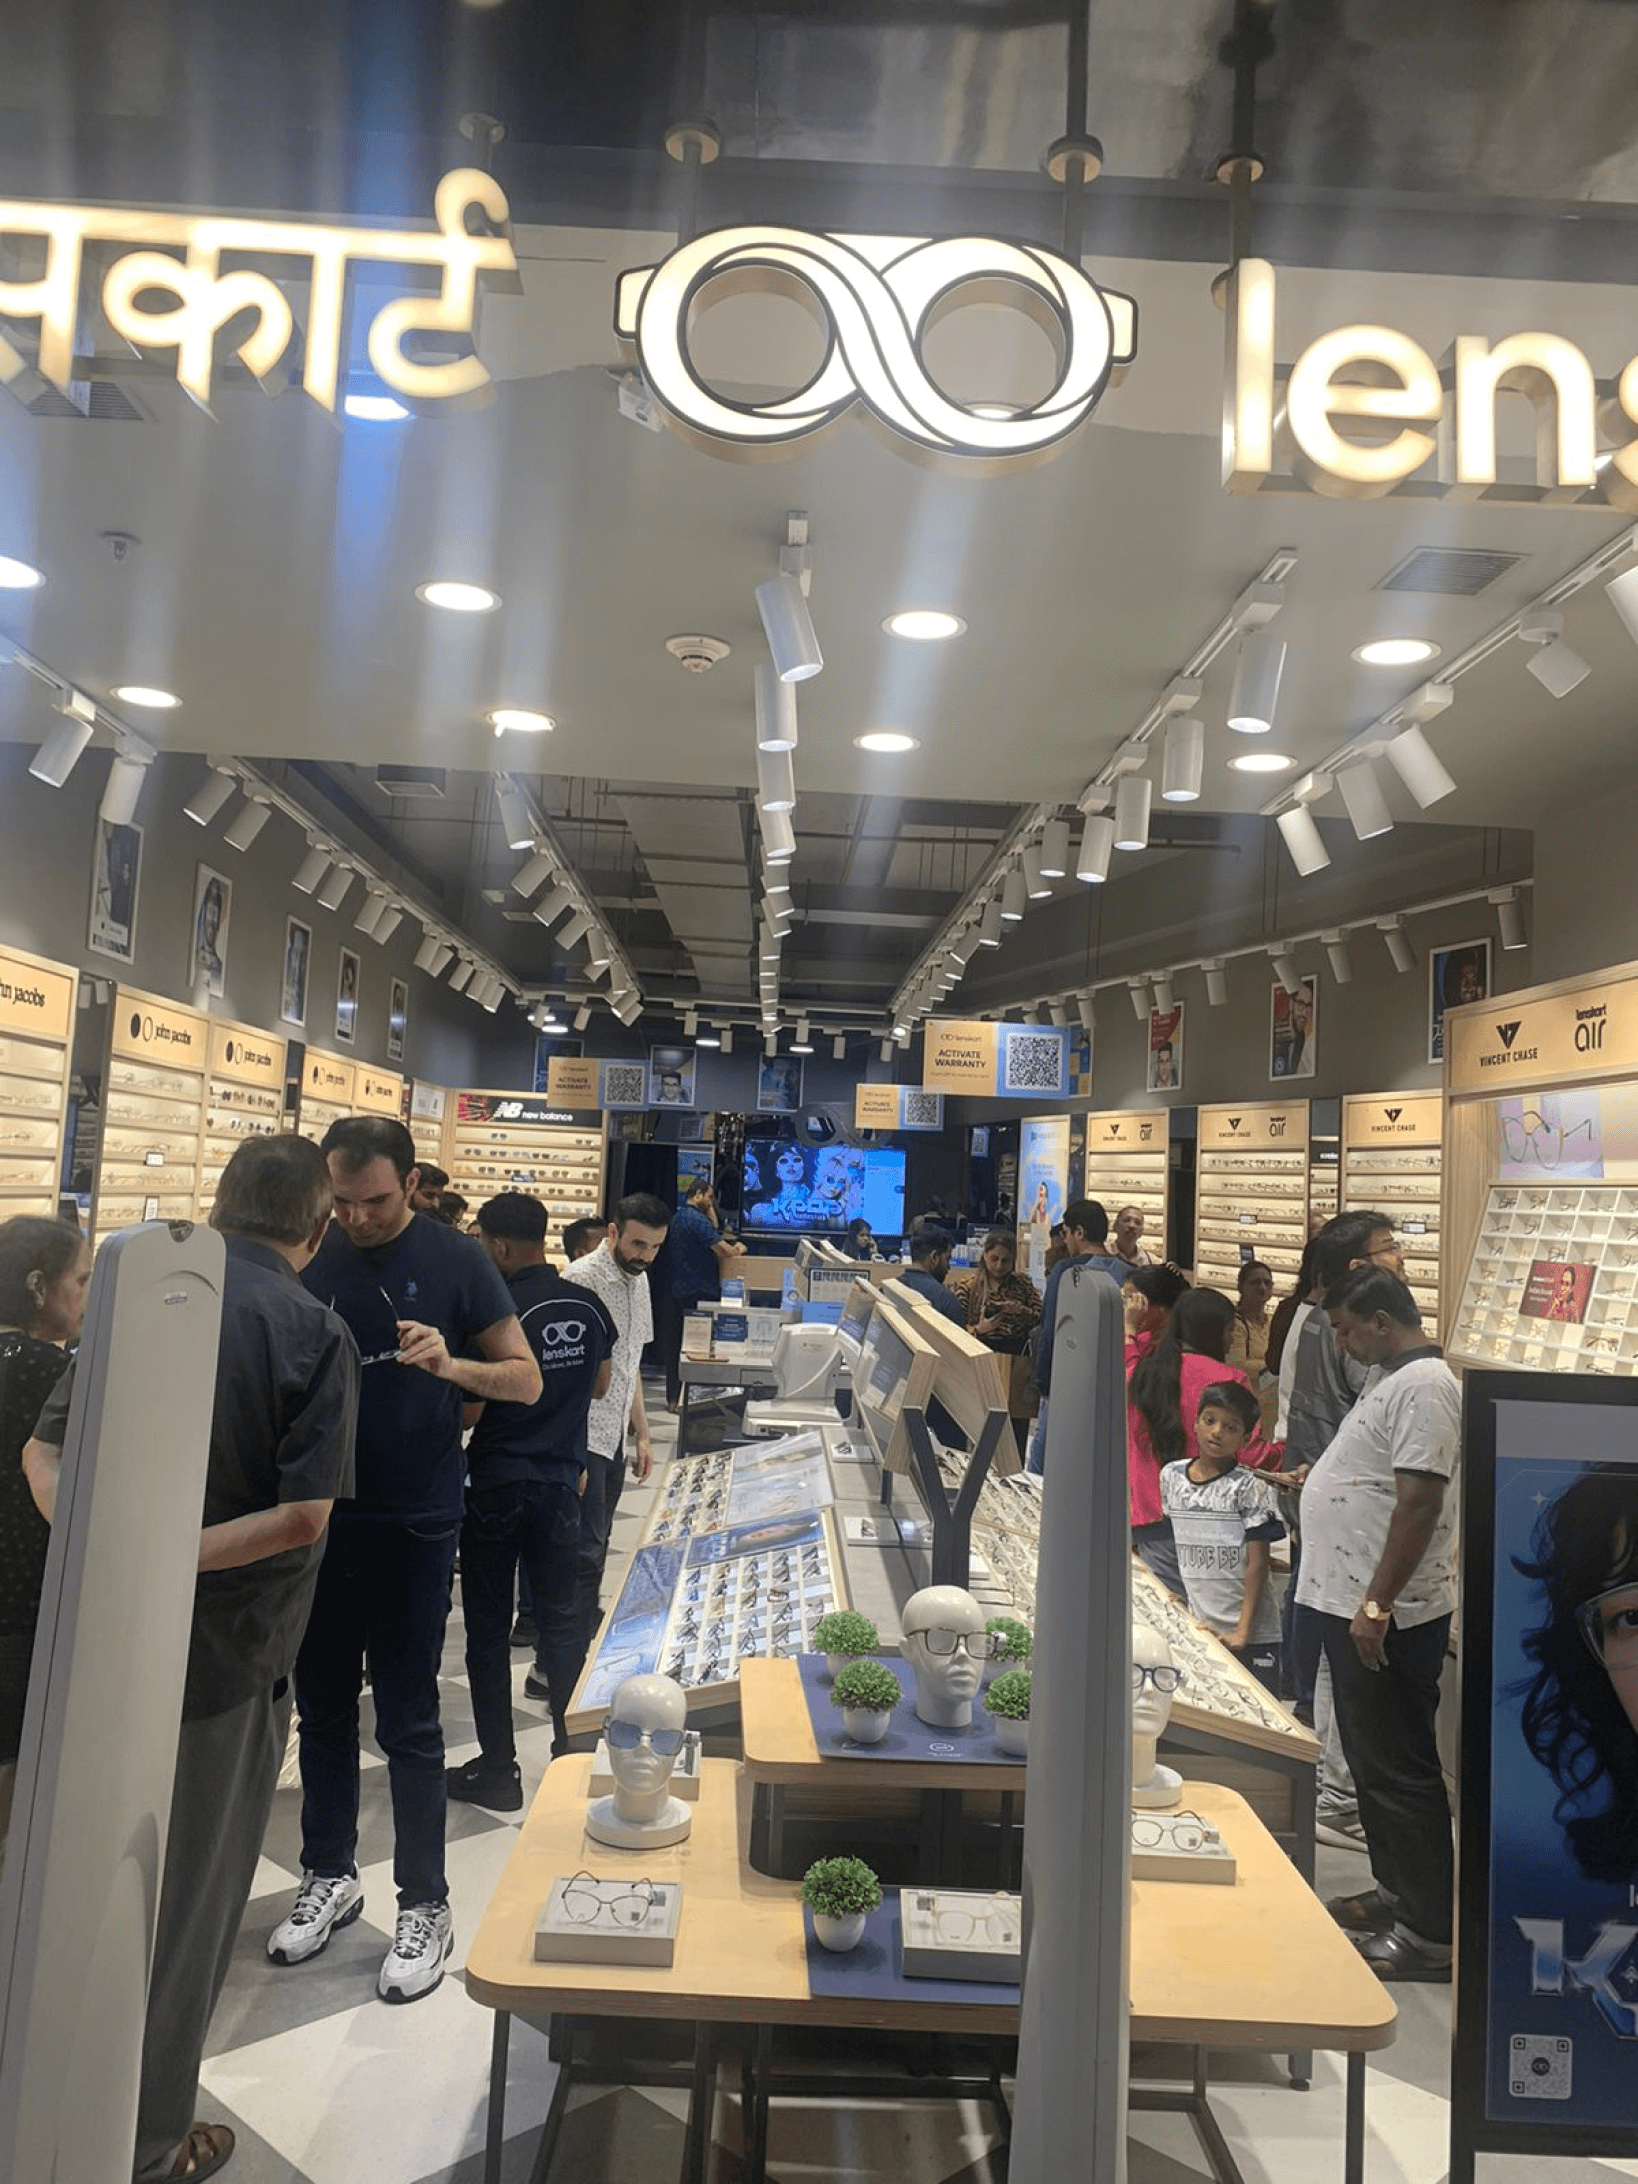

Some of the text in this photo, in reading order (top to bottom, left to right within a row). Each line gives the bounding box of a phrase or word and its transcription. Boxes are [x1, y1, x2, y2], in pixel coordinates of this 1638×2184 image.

[1237, 258, 1638, 488] len
[13, 985, 45, 1007] jacobs
[154, 1023, 191, 1046] john jacobs
[1574, 1018, 1607, 1052] air
[938, 1049, 981, 1059] ACTIVATE
[1513, 1047, 1538, 1062] CHASE
[935, 1059, 986, 1068] WARRANTY
[540, 1111, 573, 1122] balance
[1269, 1122, 1287, 1137] air
[542, 1344, 585, 1361] lenskart
